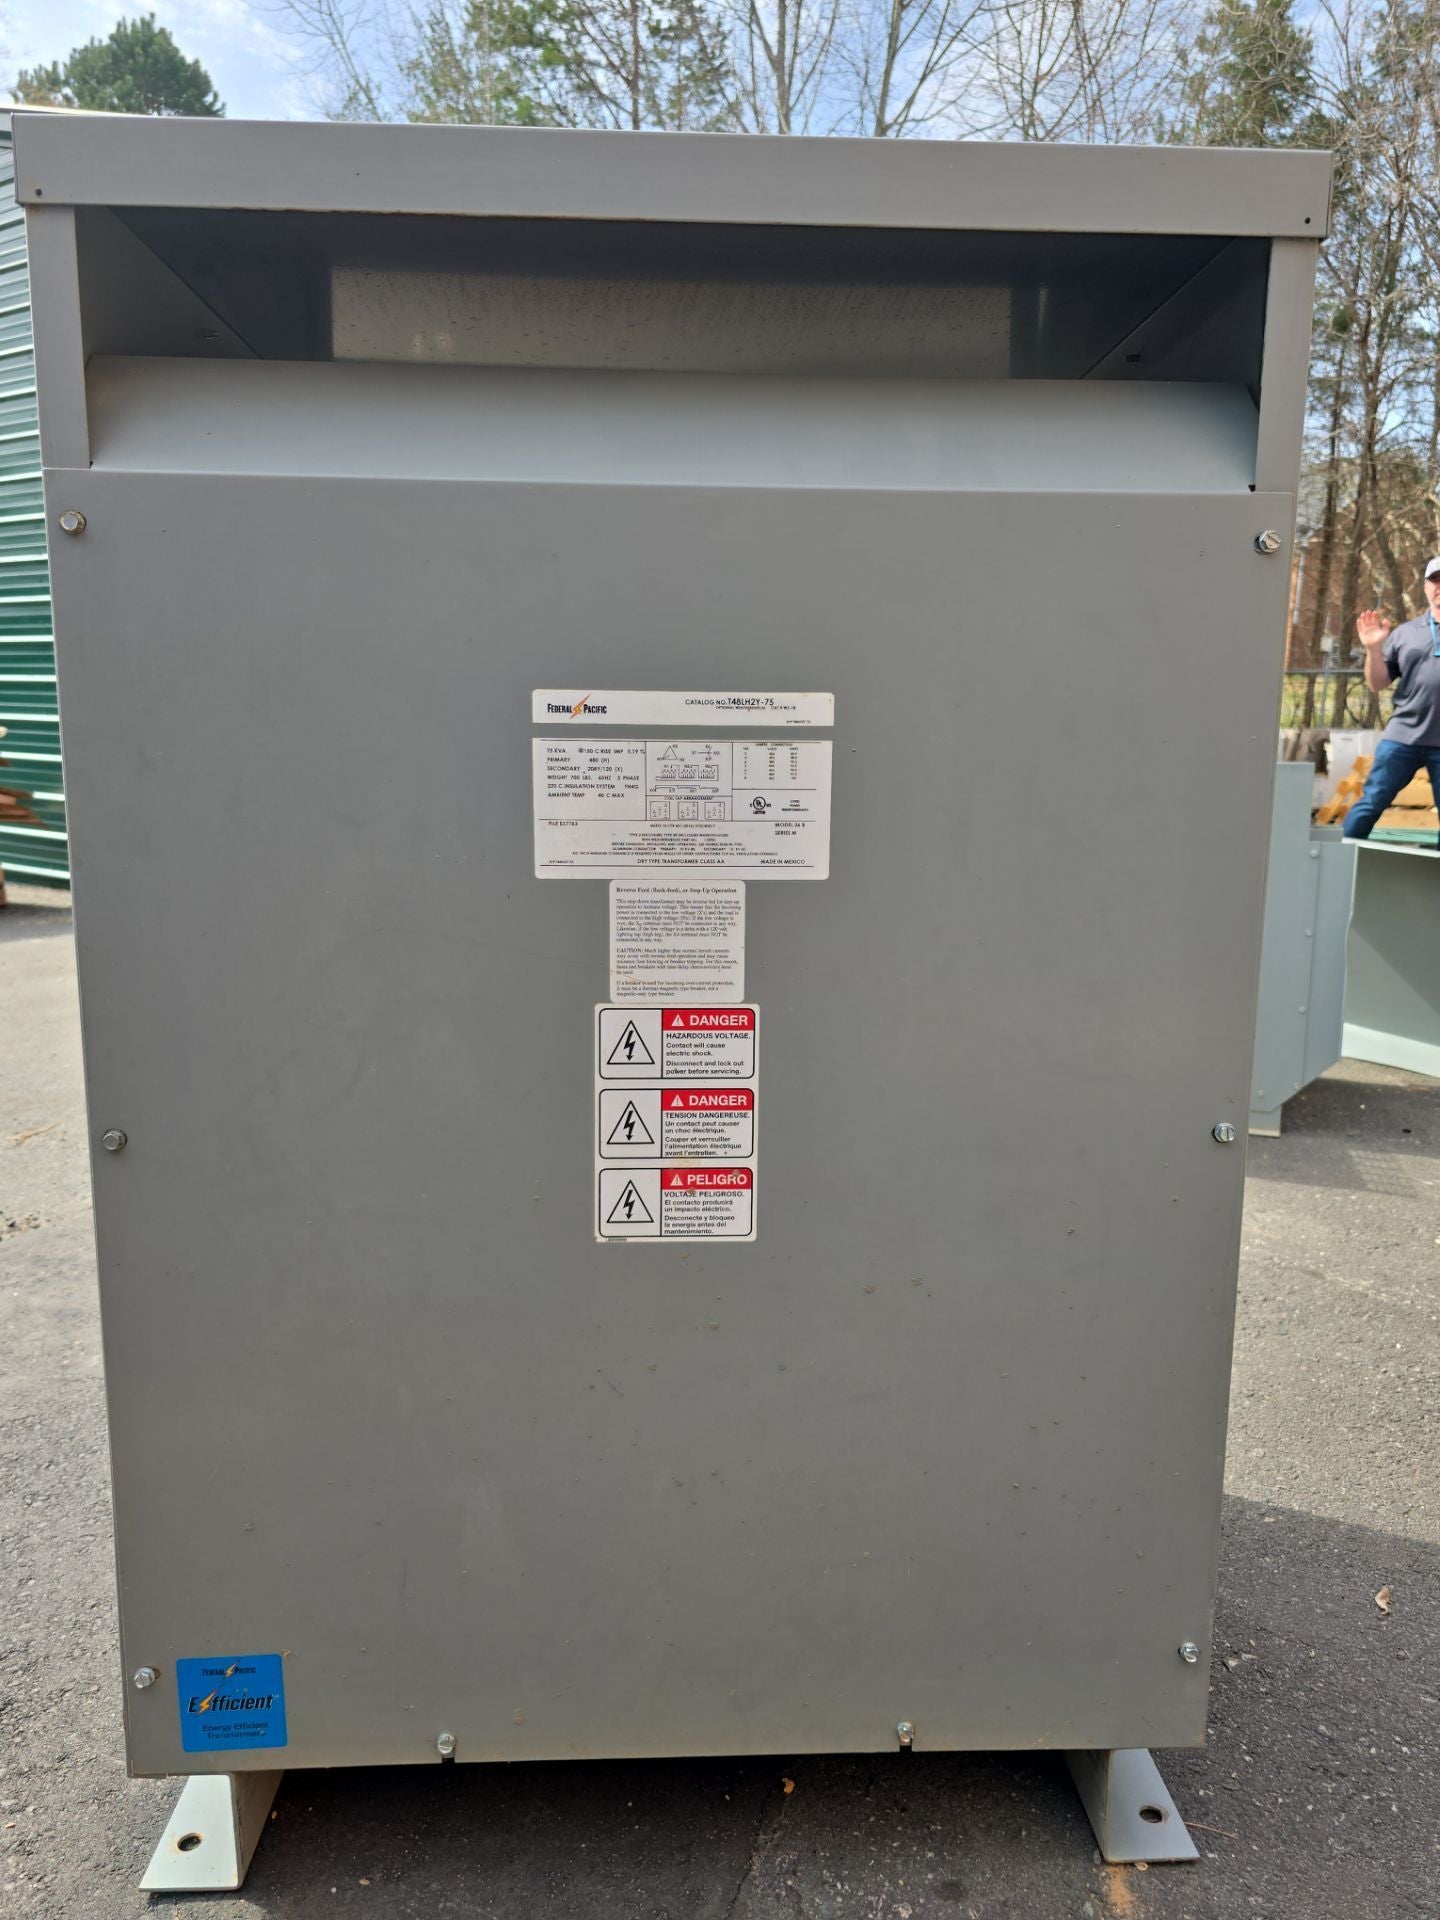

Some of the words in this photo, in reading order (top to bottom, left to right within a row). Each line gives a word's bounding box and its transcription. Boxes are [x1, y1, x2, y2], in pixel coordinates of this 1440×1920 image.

[547, 703, 573, 713] FEDERAL
[583, 704, 608, 714] PACIFIC
[689, 1014, 749, 1026] DANGER
[710, 1068, 742, 1076] servicing.
[688, 1095, 748, 1106] DANGER
[687, 1174, 748, 1185] PELIGRO
[201, 1724, 232, 1733] Energy
[233, 1722, 269, 1730] Efficient
